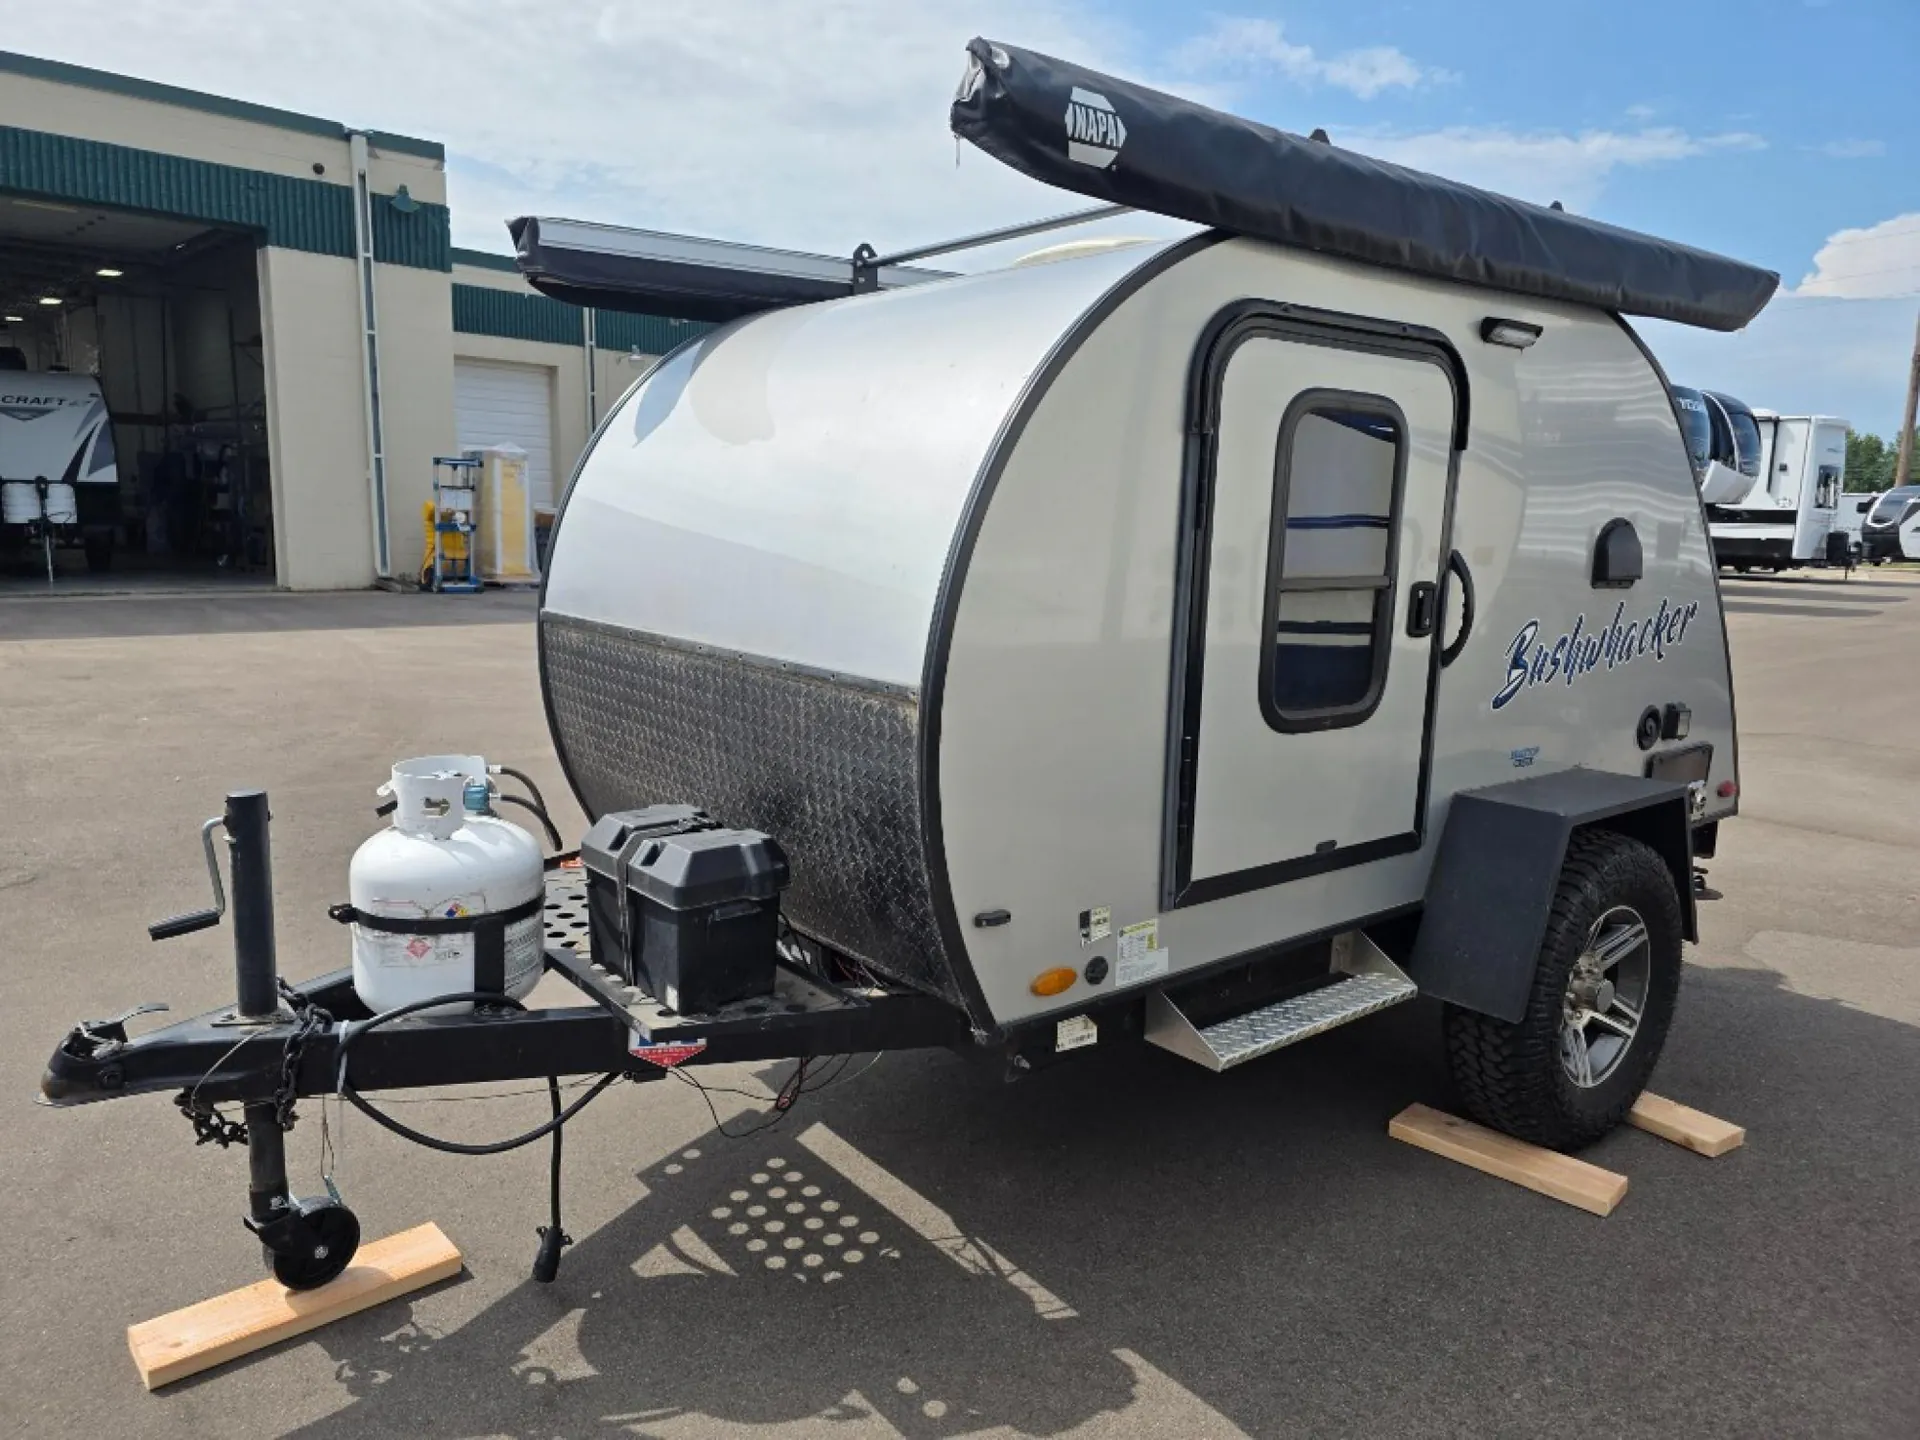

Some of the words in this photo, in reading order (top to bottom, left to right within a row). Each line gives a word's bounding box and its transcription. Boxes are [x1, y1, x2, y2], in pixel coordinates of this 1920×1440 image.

[1074, 104, 1117, 147] NAPA
[1, 395, 67, 406] CRAFT
[1491, 597, 1698, 711] Bushwhacker
